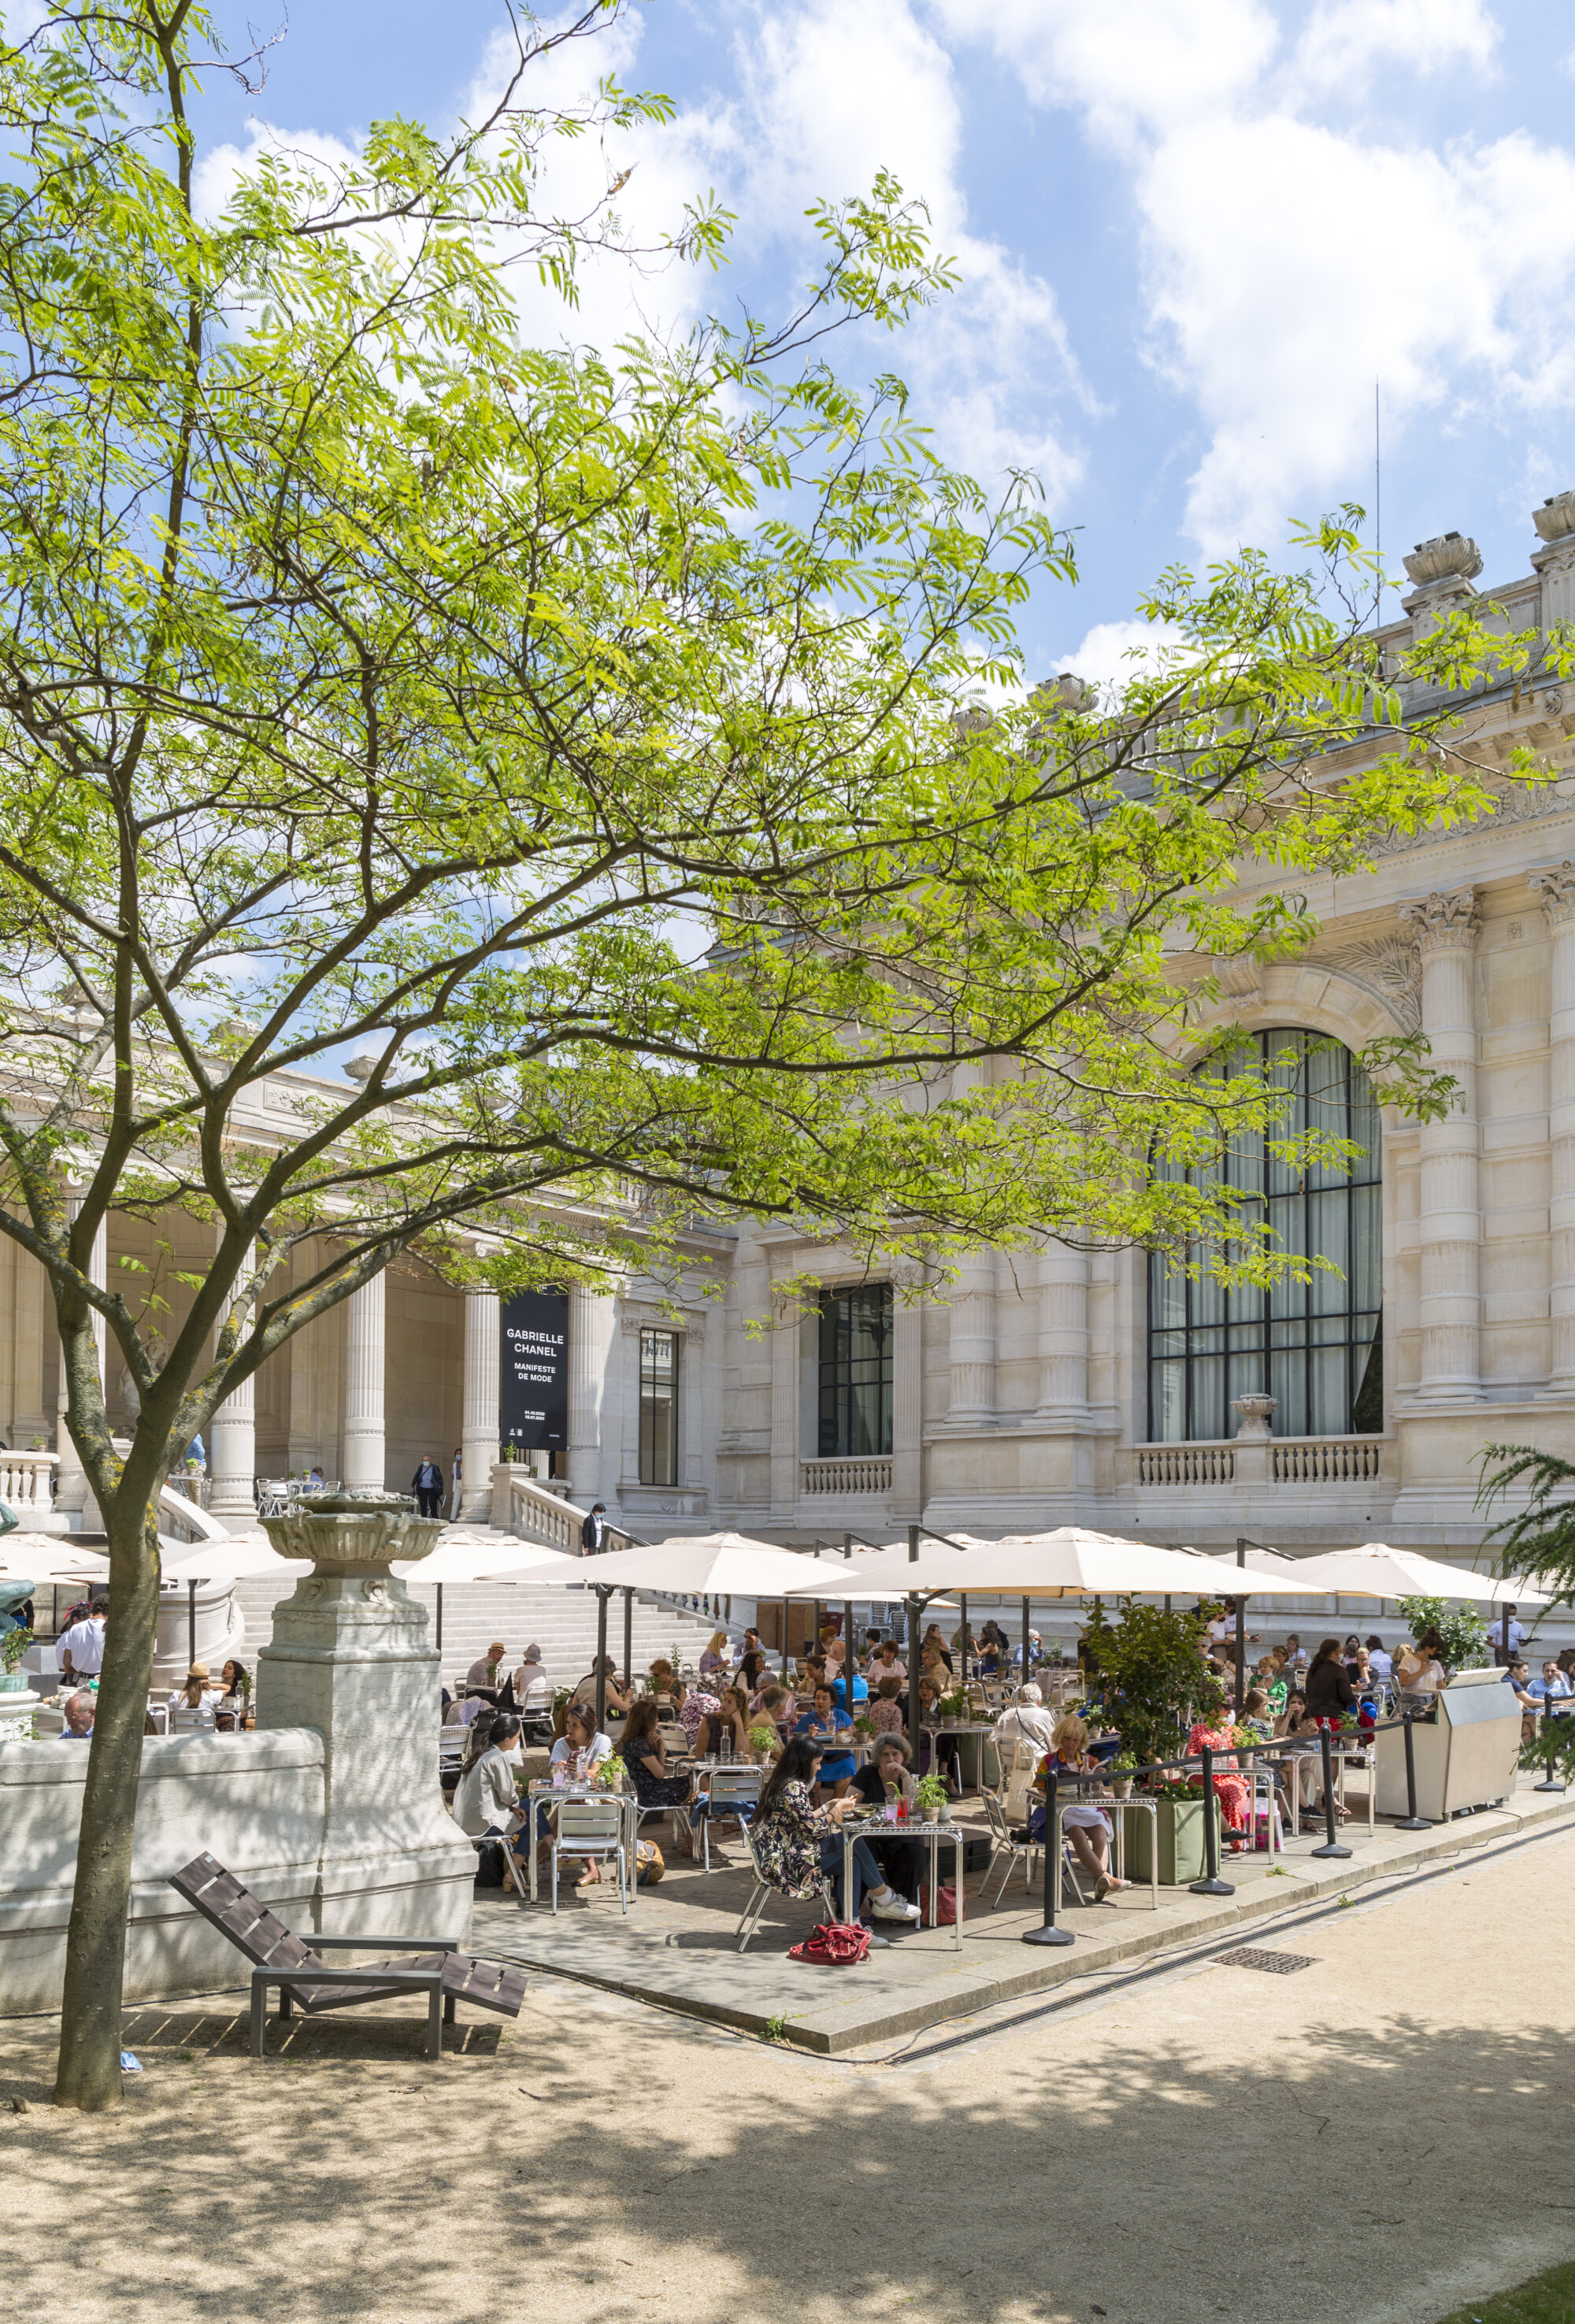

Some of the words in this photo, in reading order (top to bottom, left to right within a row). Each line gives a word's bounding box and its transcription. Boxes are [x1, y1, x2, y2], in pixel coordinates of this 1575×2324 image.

[506, 1328, 564, 1344] GABRIELLE
[514, 1343, 557, 1357] CHANEL
[514, 1362, 556, 1373] MANIFESTE
[518, 1372, 528, 1381] DE
[530, 1373, 552, 1383] MODE
